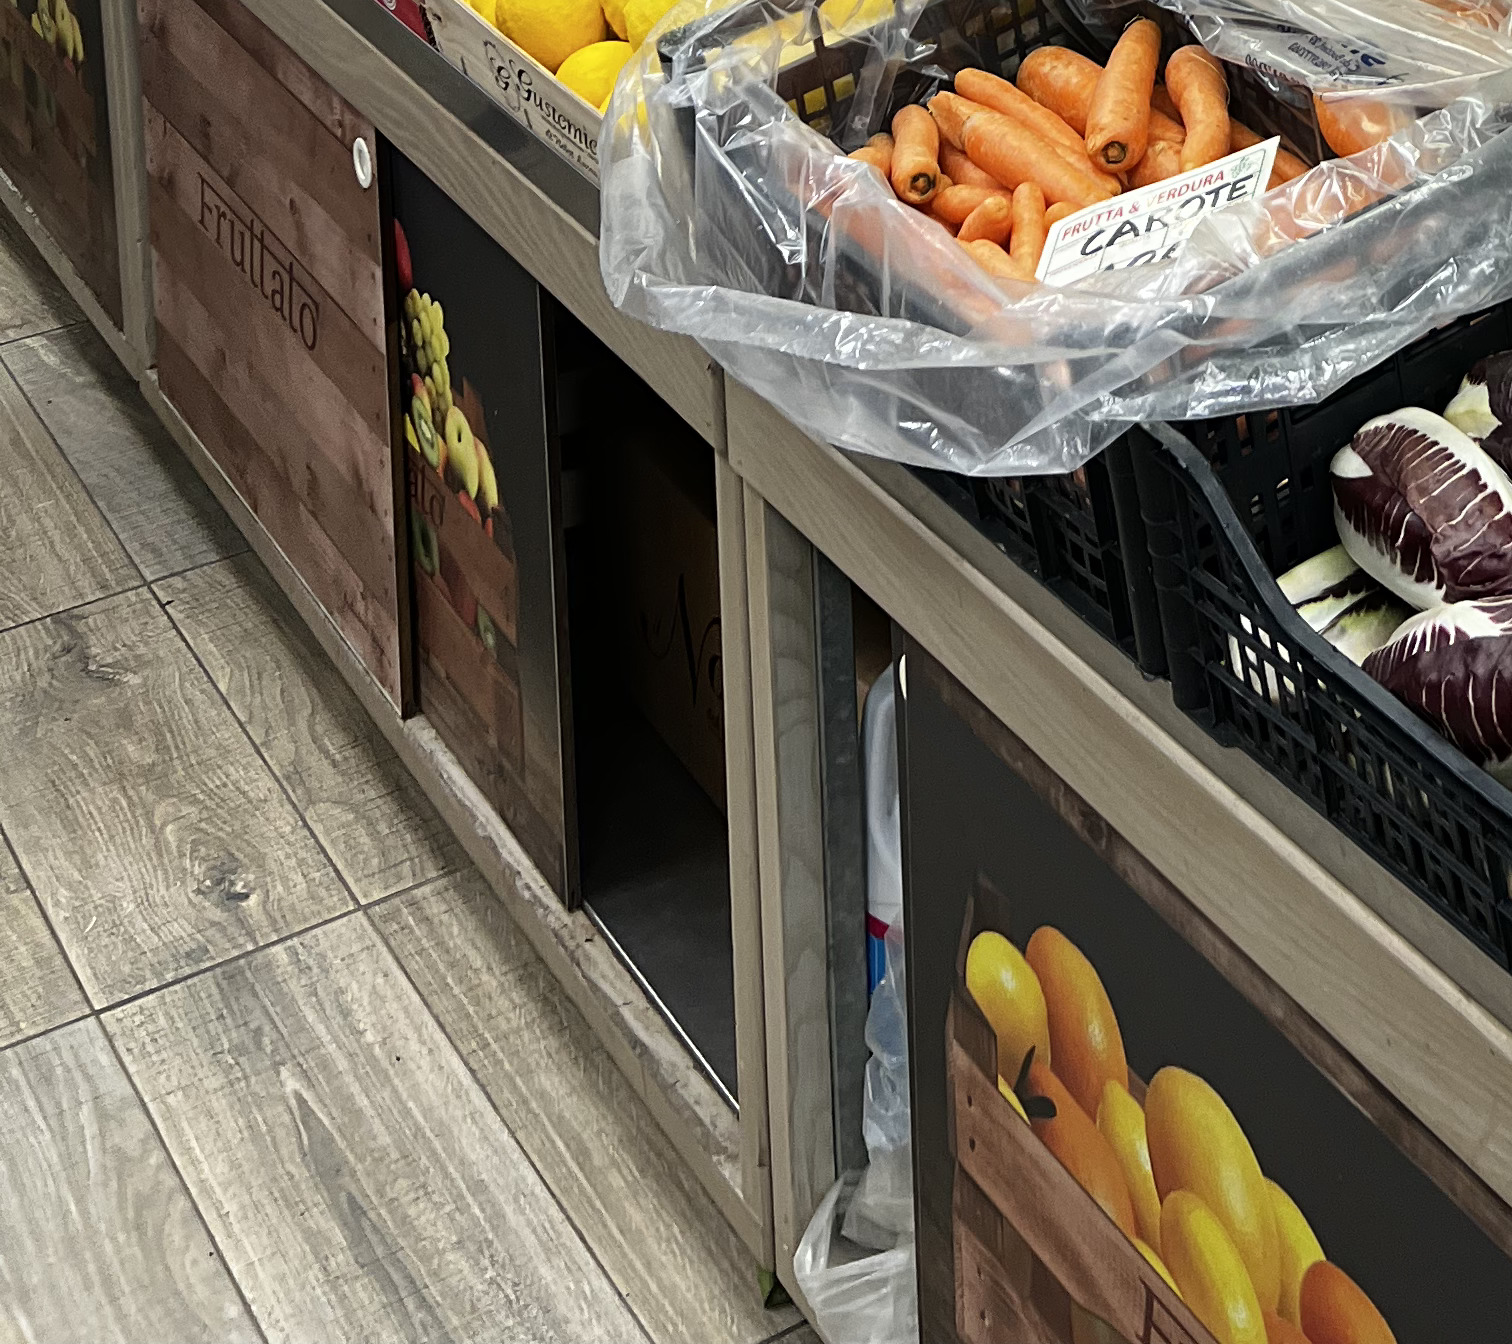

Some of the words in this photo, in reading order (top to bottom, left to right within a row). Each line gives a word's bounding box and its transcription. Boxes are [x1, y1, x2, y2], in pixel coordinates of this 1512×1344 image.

[509, 59, 599, 156] Gustemie
[1061, 207, 1124, 241] FRUTTA
[1129, 201, 1141, 215] &
[1146, 170, 1225, 209] VERDURA
[1080, 174, 1254, 256] CAROTE
[197, 172, 320, 352] Fruttato
